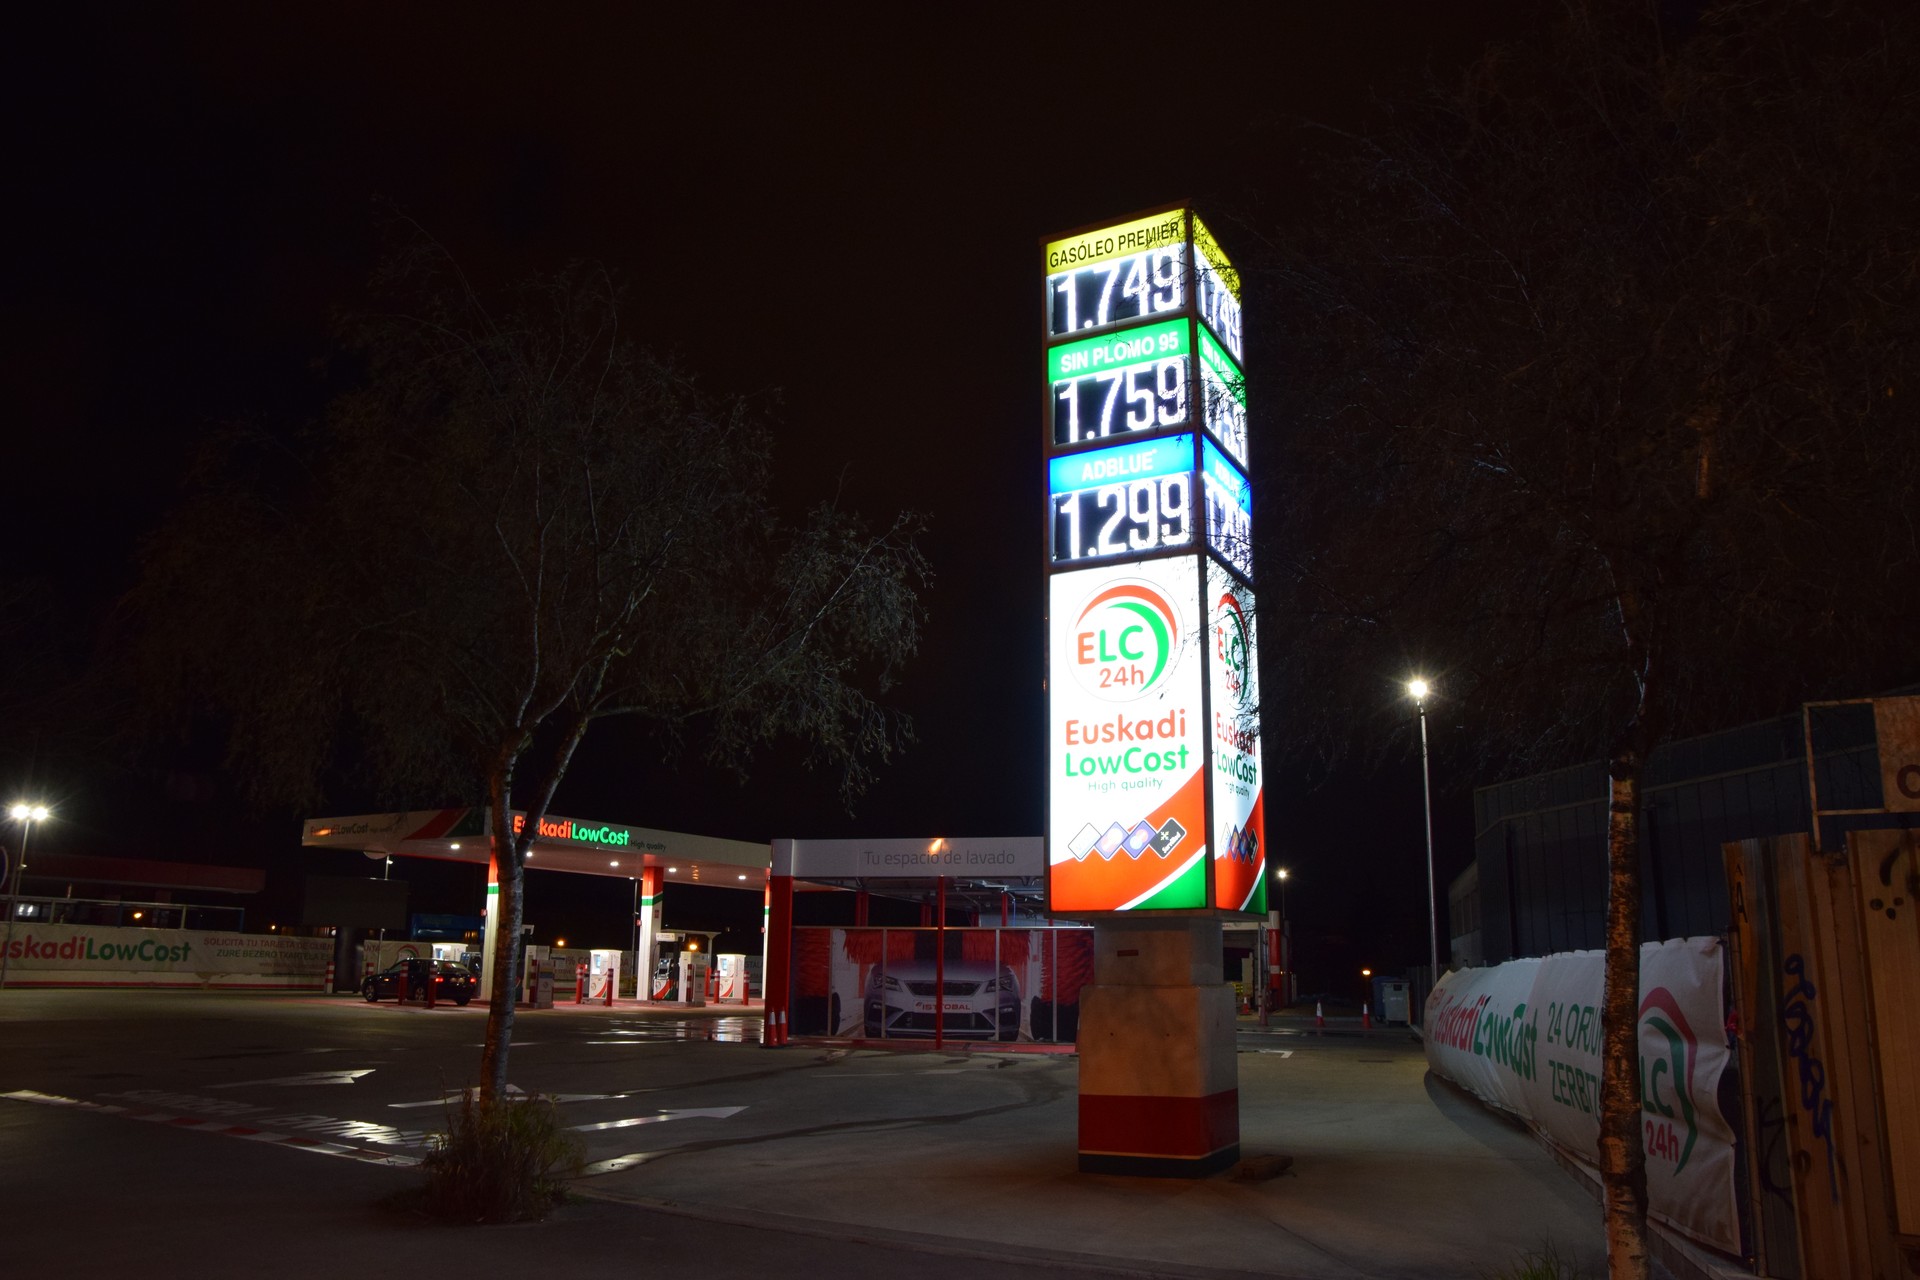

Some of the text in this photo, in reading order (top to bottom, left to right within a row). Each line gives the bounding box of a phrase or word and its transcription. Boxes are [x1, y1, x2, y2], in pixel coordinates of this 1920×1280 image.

[1050, 221, 1179, 268] GASÓLEO PREMIER
[1057, 249, 1183, 333] 1.749
[1060, 332, 1179, 373] SIN PLOMO 95
[1058, 359, 1187, 443] 1.759
[1060, 475, 1191, 560] 1.299
[1077, 624, 1145, 665] ELC
[1099, 664, 1145, 688] 24h
[1065, 708, 1186, 746] Euskadi
[1065, 743, 1190, 777] LowCost
[1088, 777, 1163, 794] High quality
[864, 849, 1016, 870] Tu espacio de lavado
[203, 937, 244, 947] SOLICITA
[246, 938, 258, 947] TU
[216, 948, 240, 958] ZURE
[243, 950, 277, 959] BEZERO
[1547, 1001, 1564, 1045] 24
[1645, 1119, 1679, 1163] 24h
